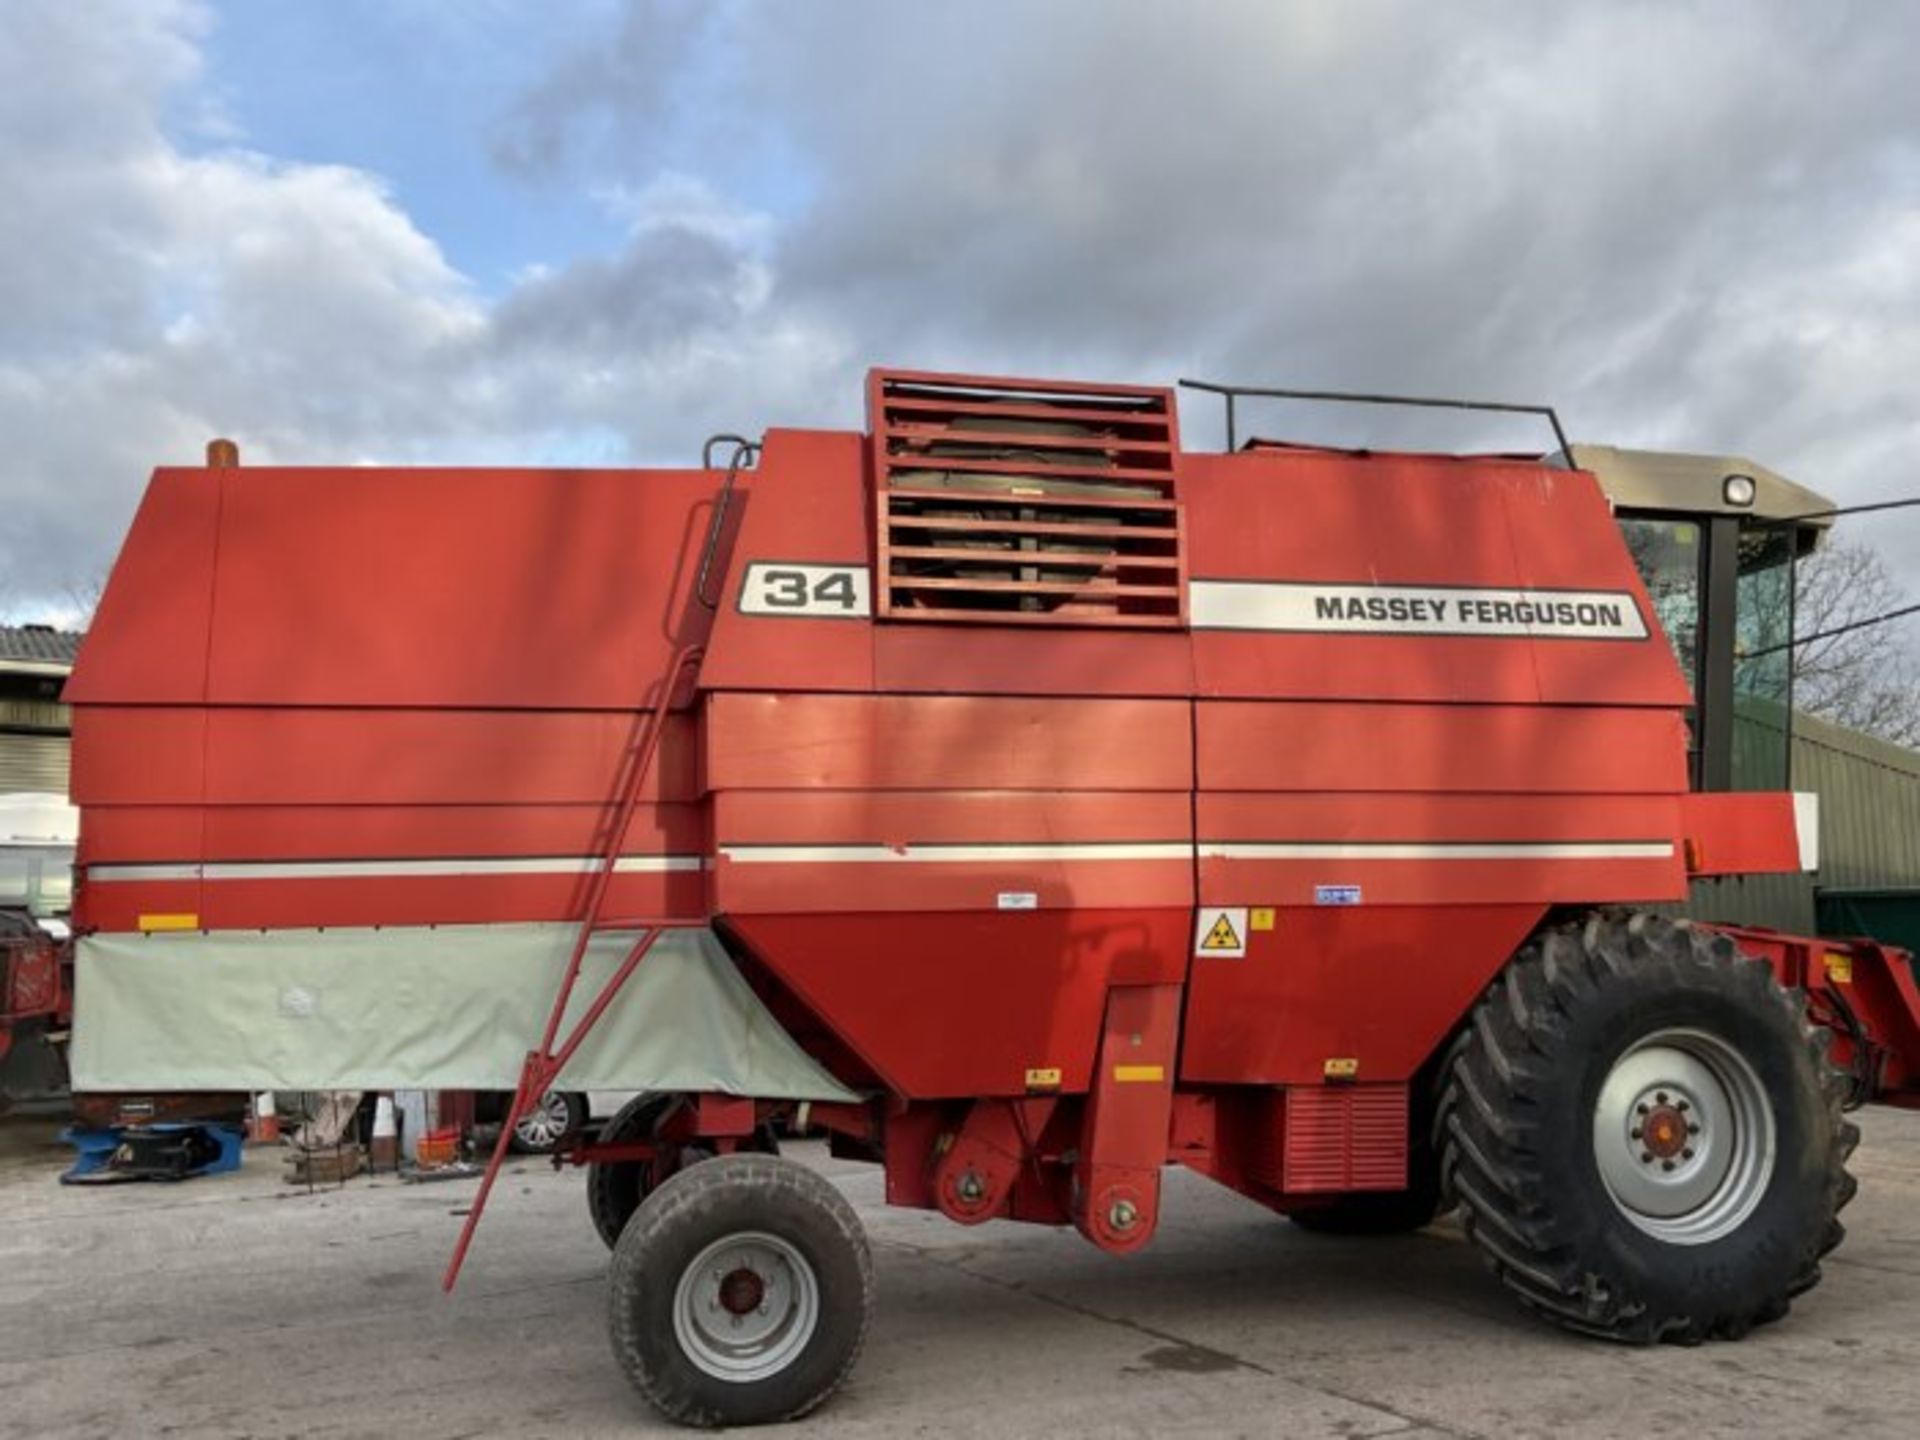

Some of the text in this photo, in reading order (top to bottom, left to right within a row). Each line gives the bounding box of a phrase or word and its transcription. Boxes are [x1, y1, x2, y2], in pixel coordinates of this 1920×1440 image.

[763, 570, 857, 609] 34
[1315, 596, 1623, 627] MASSEY FERGUSON
